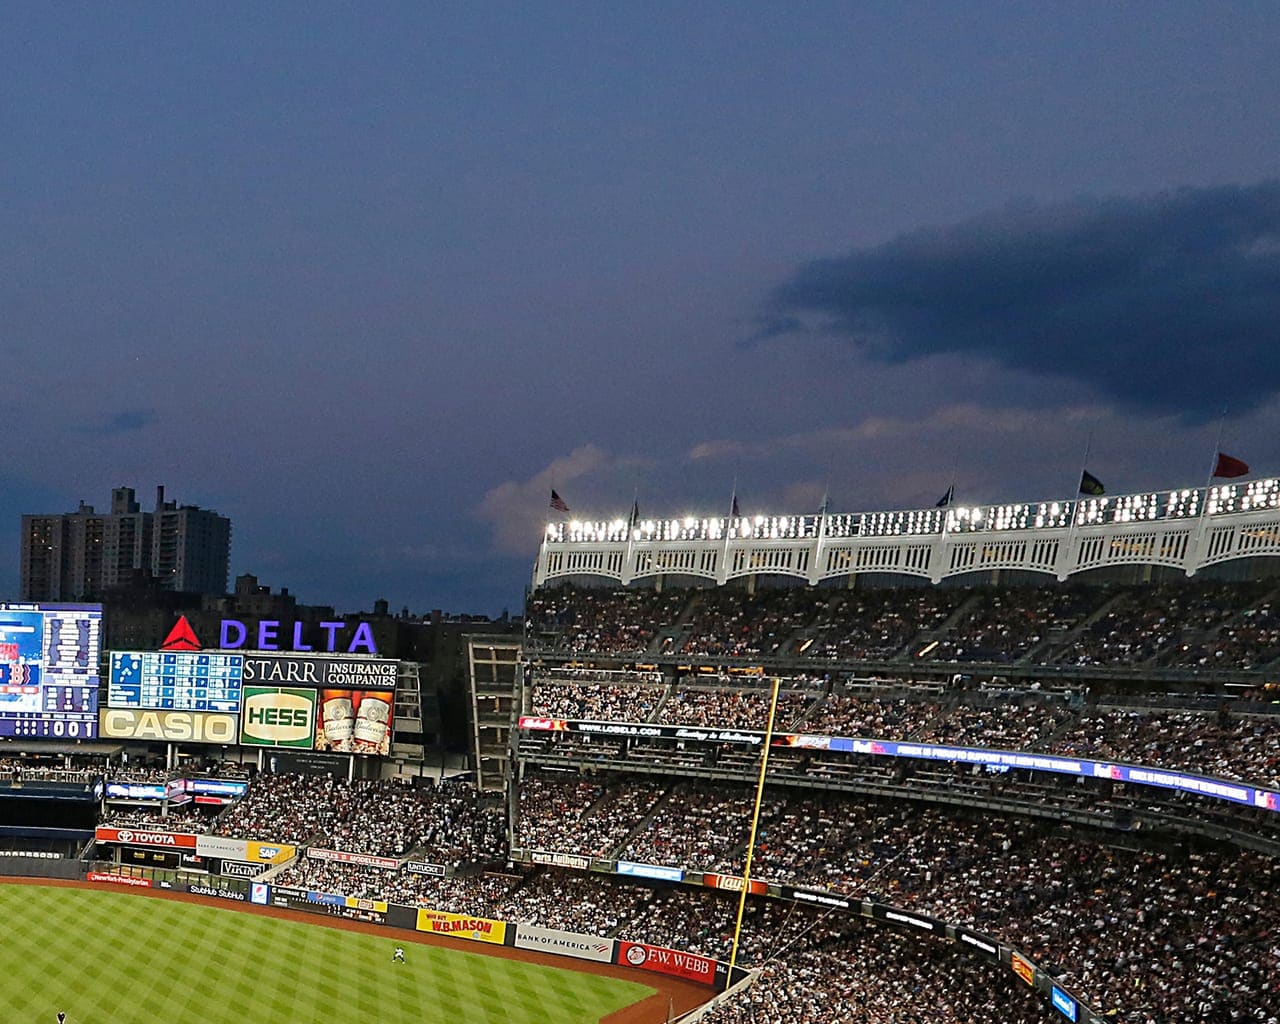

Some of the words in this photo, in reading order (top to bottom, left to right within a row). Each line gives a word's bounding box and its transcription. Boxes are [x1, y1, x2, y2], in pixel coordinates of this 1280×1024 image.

[221, 620, 378, 653] DELTA
[244, 660, 319, 682] STARR
[328, 664, 397, 675] INSURANCE
[327, 674, 396, 686] COMPANIES
[248, 707, 308, 726] HESS
[54, 721, 64, 736] 0
[69, 721, 79, 736] 0
[86, 722, 92, 737] 1
[105, 710, 235, 742] CASIO
[134, 832, 176, 845] TOYOTA
[183, 853, 202, 863] FedEx
[259, 848, 276, 858] SAP
[532, 852, 551, 863] Parts
[552, 855, 589, 868] Authority
[190, 885, 217, 896] StubHub
[218, 890, 245, 901] StubHub
[518, 934, 539, 943] BANK
[541, 937, 552, 945] OF
[553, 939, 591, 951] AMERICA
[648, 949, 670, 966] F.W.
[674, 954, 709, 974] WEBB
